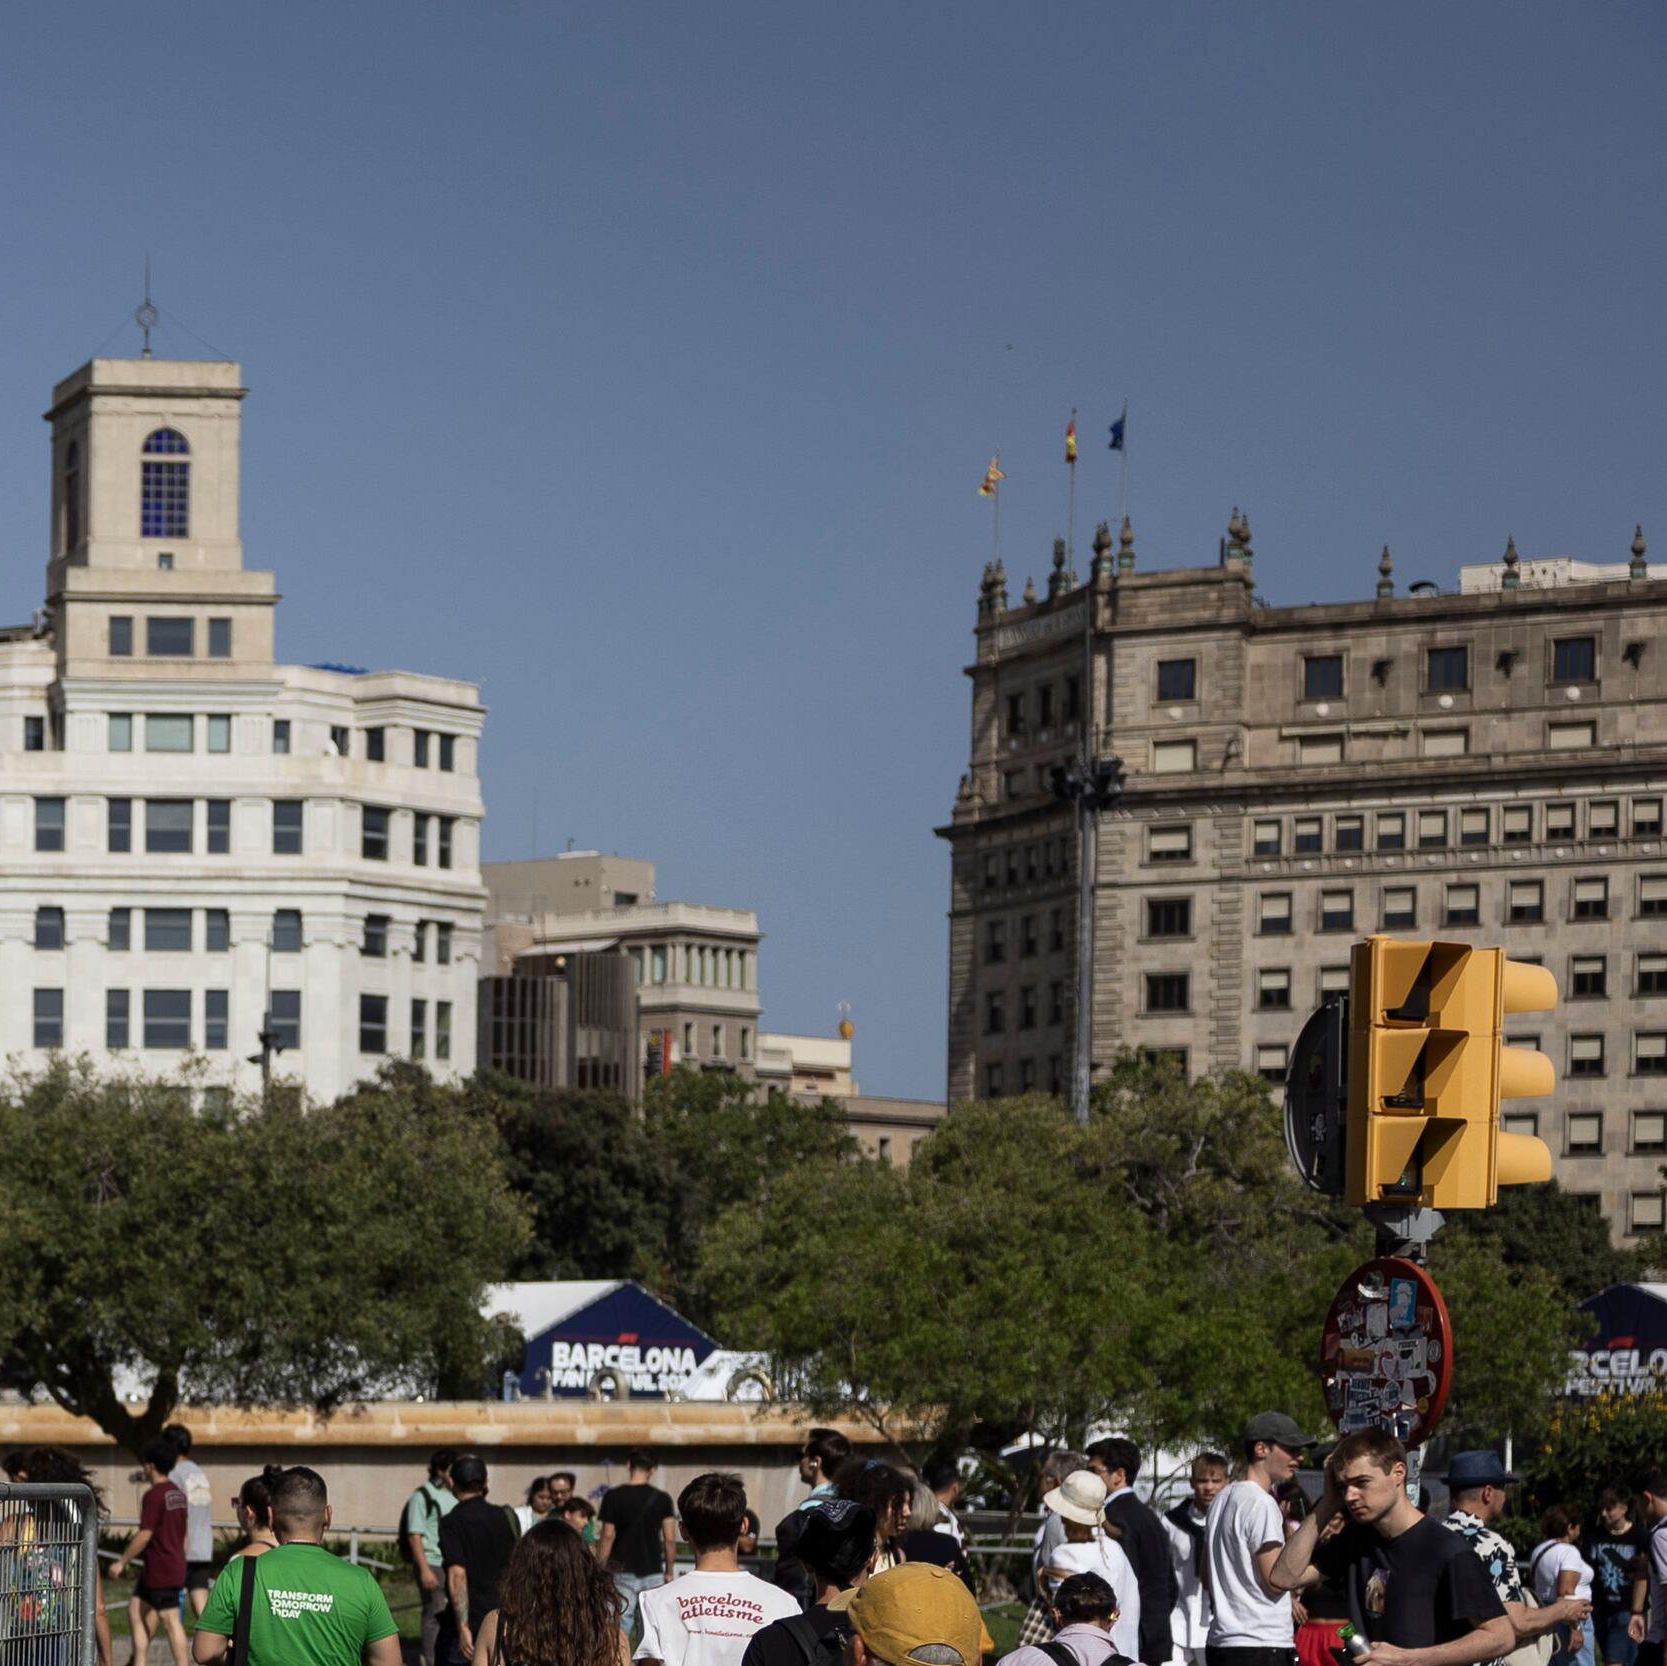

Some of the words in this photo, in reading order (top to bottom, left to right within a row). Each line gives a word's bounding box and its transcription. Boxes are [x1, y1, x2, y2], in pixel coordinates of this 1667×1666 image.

[552, 1341, 698, 1374] BARCELONA
[552, 1369, 585, 1388] FAN
[267, 1588, 334, 1604] TRANSFORM
[676, 1592, 764, 1613] barcelona
[681, 1603, 764, 1625] atletisme
